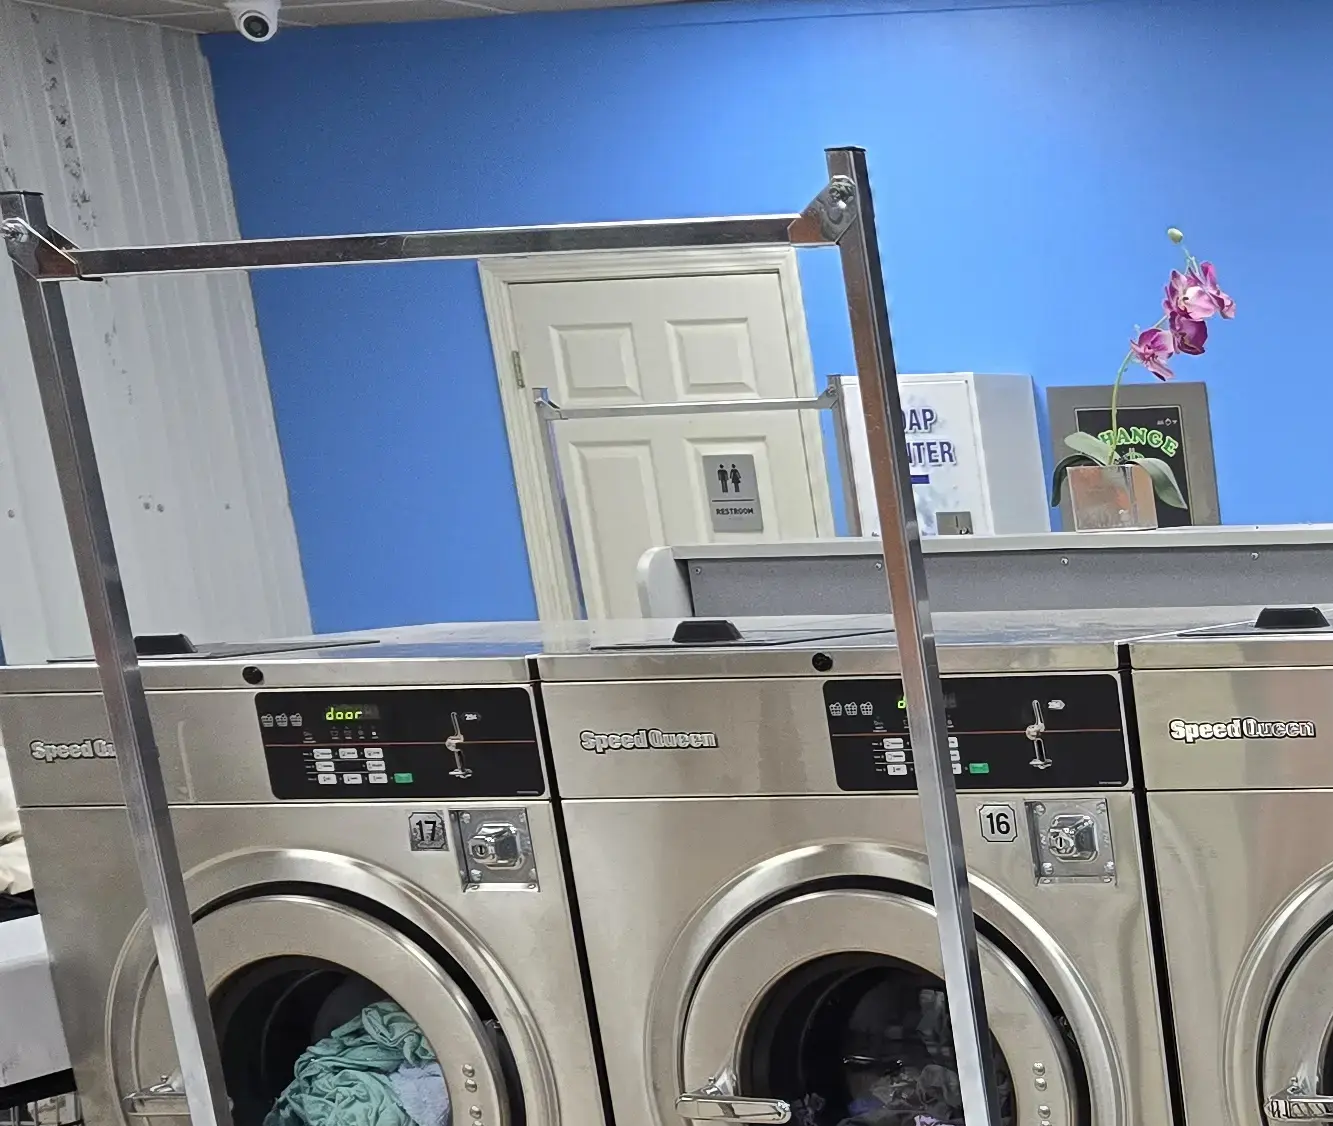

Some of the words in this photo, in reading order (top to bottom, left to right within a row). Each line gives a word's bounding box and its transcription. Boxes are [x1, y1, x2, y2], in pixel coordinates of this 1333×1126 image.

[900, 408, 936, 432] AP
[1097, 427, 1179, 457] HANGE
[716, 507, 754, 515] RESTROOM
[325, 707, 363, 721] door
[580, 729, 648, 754] Speed
[648, 728, 719, 749] Queen
[1169, 718, 1242, 744] Speed
[1242, 717, 1316, 738] Queen
[30, 738, 94, 763] Speed
[415, 820, 437, 841] 17
[985, 812, 1010, 835] 16
